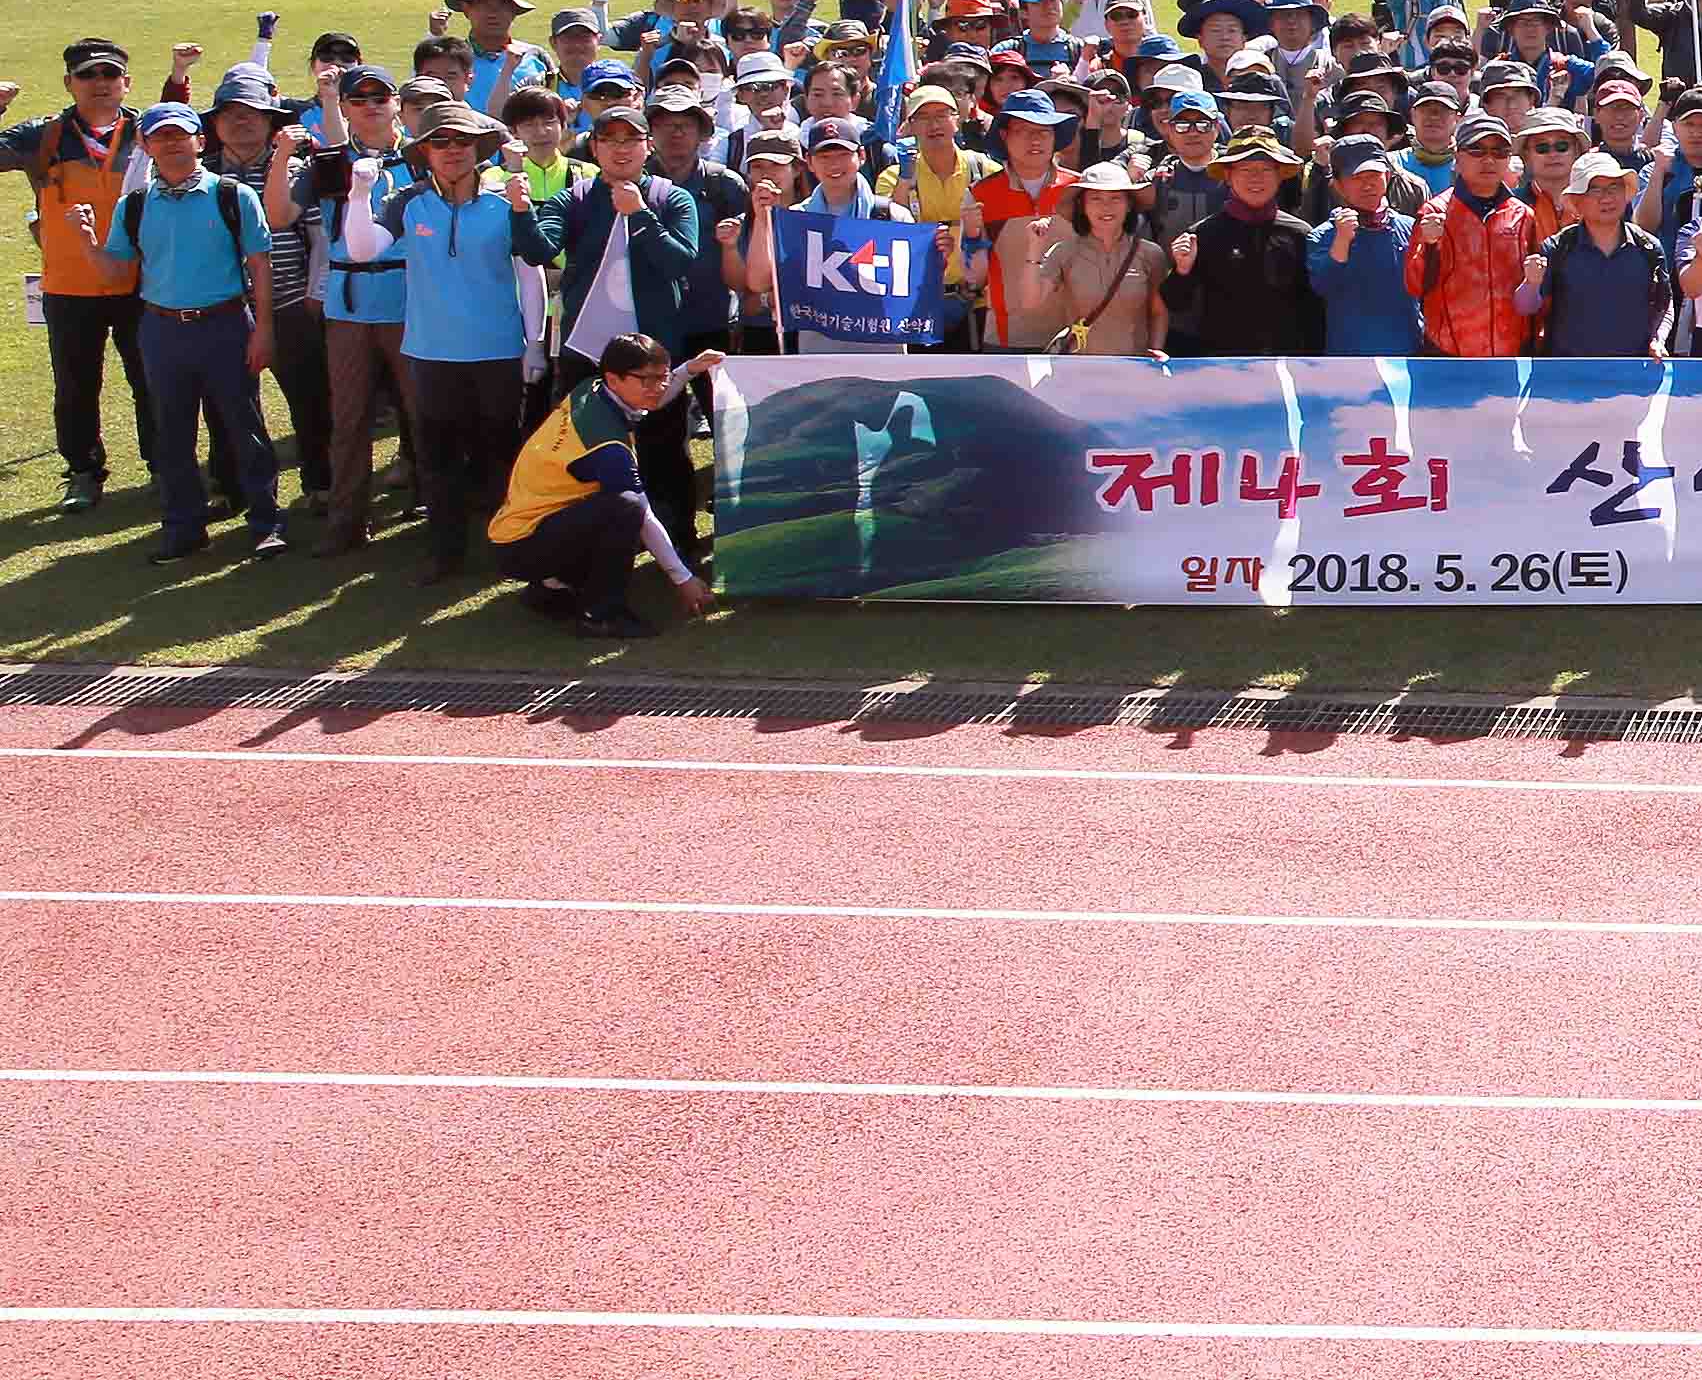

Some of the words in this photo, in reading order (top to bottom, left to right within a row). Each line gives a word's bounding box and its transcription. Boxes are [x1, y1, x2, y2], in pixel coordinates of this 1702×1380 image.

[806, 230, 909, 297] ktl
[897, 316, 936, 334] 산악회
[1092, 437, 1448, 519] 제4회
[1181, 555, 1264, 592] 일자
[1287, 552, 1419, 593] 2018.
[1435, 552, 1476, 592] 5.
[1490, 549, 1628, 594] 26(토)
